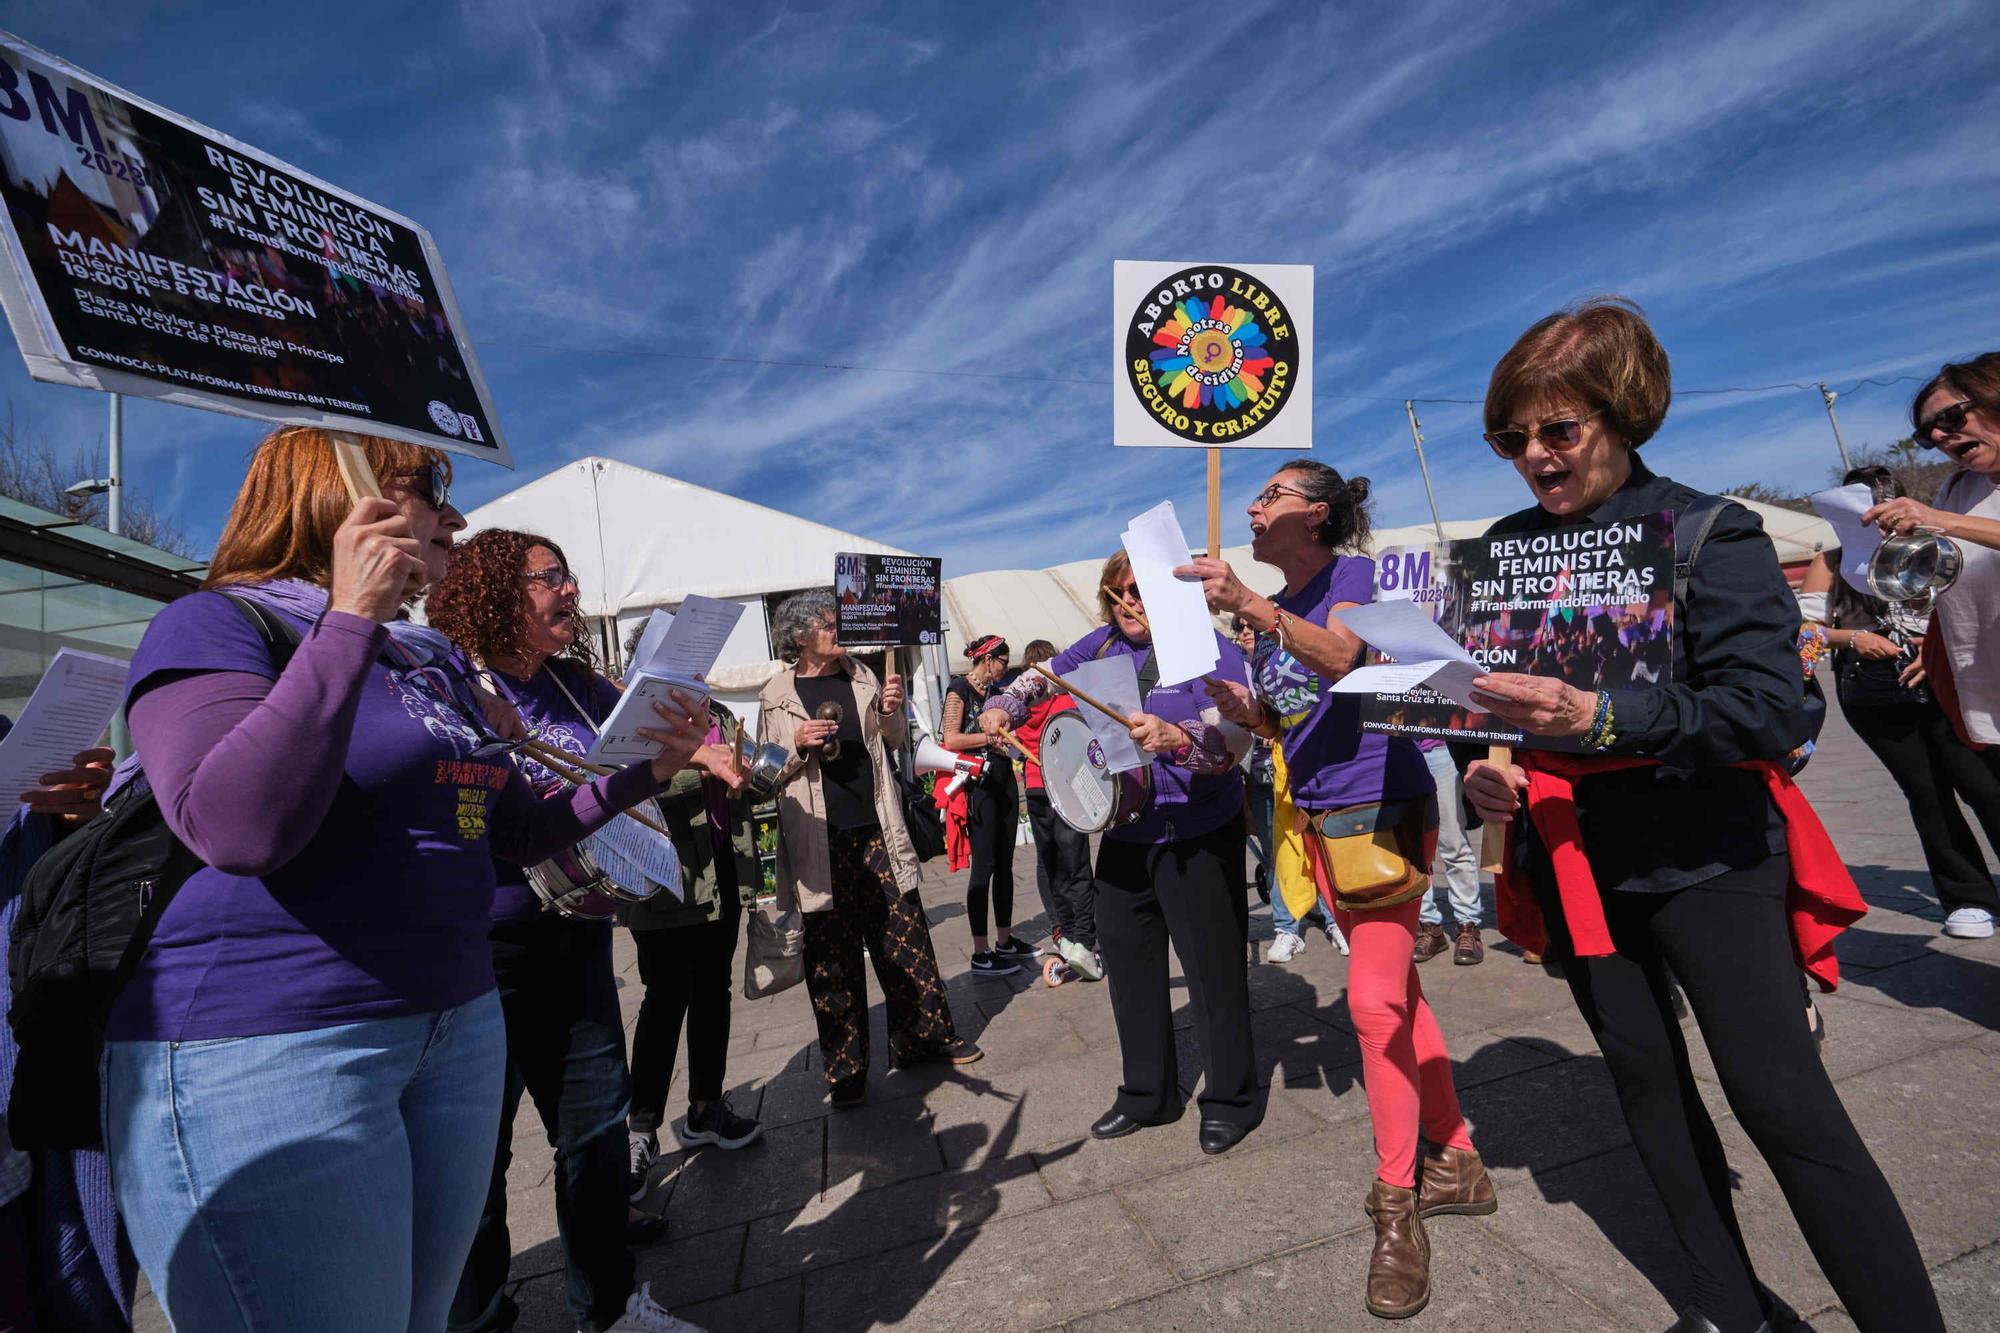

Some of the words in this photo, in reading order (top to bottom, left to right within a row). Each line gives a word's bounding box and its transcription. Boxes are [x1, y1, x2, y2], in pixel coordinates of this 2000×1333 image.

[76, 146, 146, 188] 2023
[204, 144, 395, 243] REVOLUCIÓN
[229, 176, 387, 257] FEMINISTA
[196, 186, 257, 225] SIN
[263, 211, 422, 288] FRONTERAS
[46, 222, 318, 319] MANIFESTACIÓN
[61, 260, 128, 291] 19:00
[135, 280, 151, 297] h
[209, 213, 425, 304] #TransformandoElMundo
[58, 249, 171, 292] miércoles
[174, 279, 189, 296] 8
[192, 285, 221, 304] de
[225, 295, 285, 321] marzo
[1137, 272, 1224, 338] ABORTO
[74, 287, 130, 313] Plaza
[131, 302, 195, 330] Weyler
[199, 322, 210, 332] a
[213, 325, 257, 345] Plaza
[260, 335, 285, 350] del
[78, 300, 138, 326] Santa
[141, 317, 183, 337] Cruz
[186, 329, 209, 343] de
[212, 334, 277, 358] Tenerife
[1229, 277, 1290, 341] LIBRE
[1176, 317, 1231, 357] Nosotras
[76, 345, 156, 371] CONVOCA:
[157, 364, 245, 391] PLATAFORMA
[246, 384, 306, 402] FEMINISTA
[307, 394, 325, 404] 8M
[326, 397, 372, 413] TENERIFE
[1186, 339, 1244, 386] decidimos
[1134, 358, 1190, 431] SEGURO
[1192, 420, 1210, 437] Y
[1211, 360, 1289, 437] GRATUITO
[1489, 522, 1643, 559] REVOLUCIÓN
[837, 556, 859, 575] 8M
[875, 574, 888, 582] SIN
[891, 575, 936, 584] FRONTERAS
[881, 557, 932, 567] REVOLUCIÓN
[885, 566, 926, 575] FEMINISTA
[1379, 551, 1431, 591] 8M
[1470, 579, 1505, 598] SIN
[1511, 566, 1655, 595] FRONTERAS
[1498, 548, 1625, 577] FEMINISTA
[841, 604, 896, 612] MANIFESTACIÓN
[1412, 589, 1443, 602] 2023
[1470, 592, 1650, 612] #TransformandoElMundo
[1376, 692, 1401, 702] Santa
[1402, 695, 1422, 703] Cruz
[1424, 696, 1435, 704] de
[1363, 721, 1397, 731] CONVOCA:
[1398, 725, 1441, 735] PLATAFORMA
[1442, 728, 1476, 738] FEMINISTA
[1477, 731, 1488, 739] 8M
[1489, 732, 1524, 742] TENERIFE
